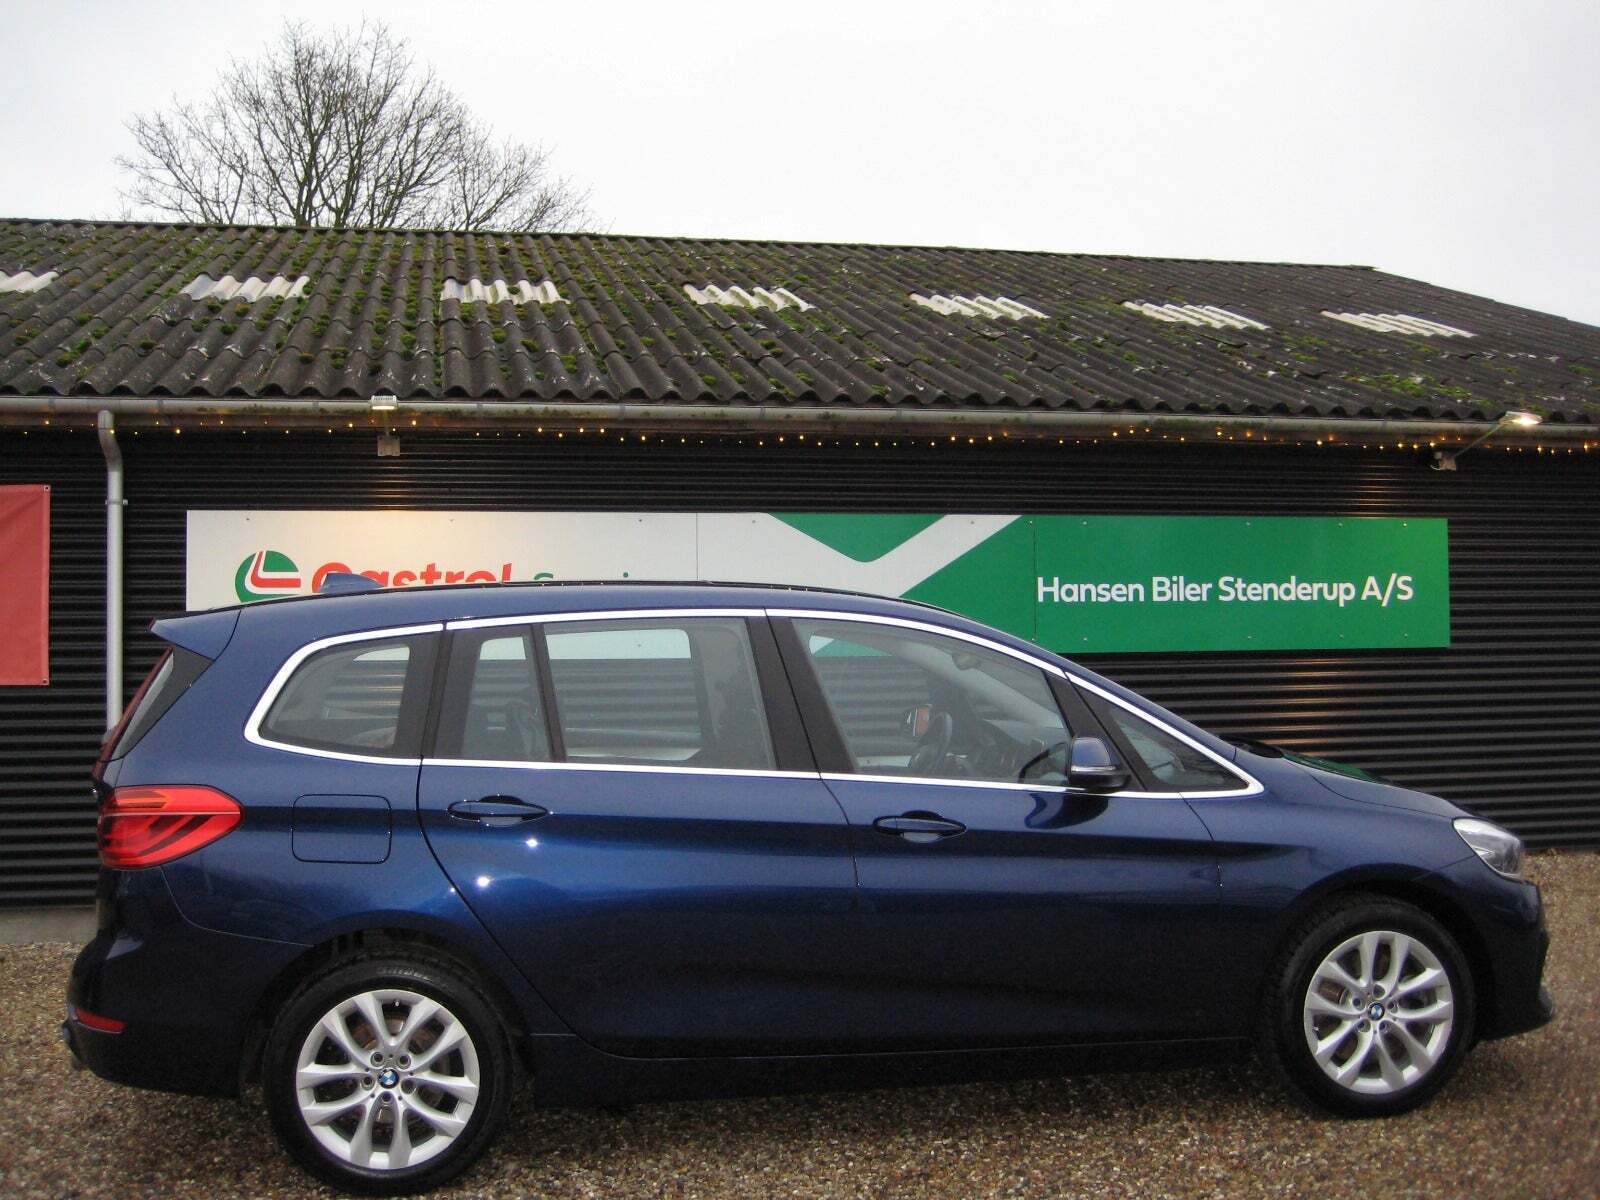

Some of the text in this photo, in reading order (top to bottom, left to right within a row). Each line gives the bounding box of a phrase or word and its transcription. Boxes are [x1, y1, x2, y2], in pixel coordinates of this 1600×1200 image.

[1037, 572, 1414, 608] Hansen Biler Stenderup A/S
